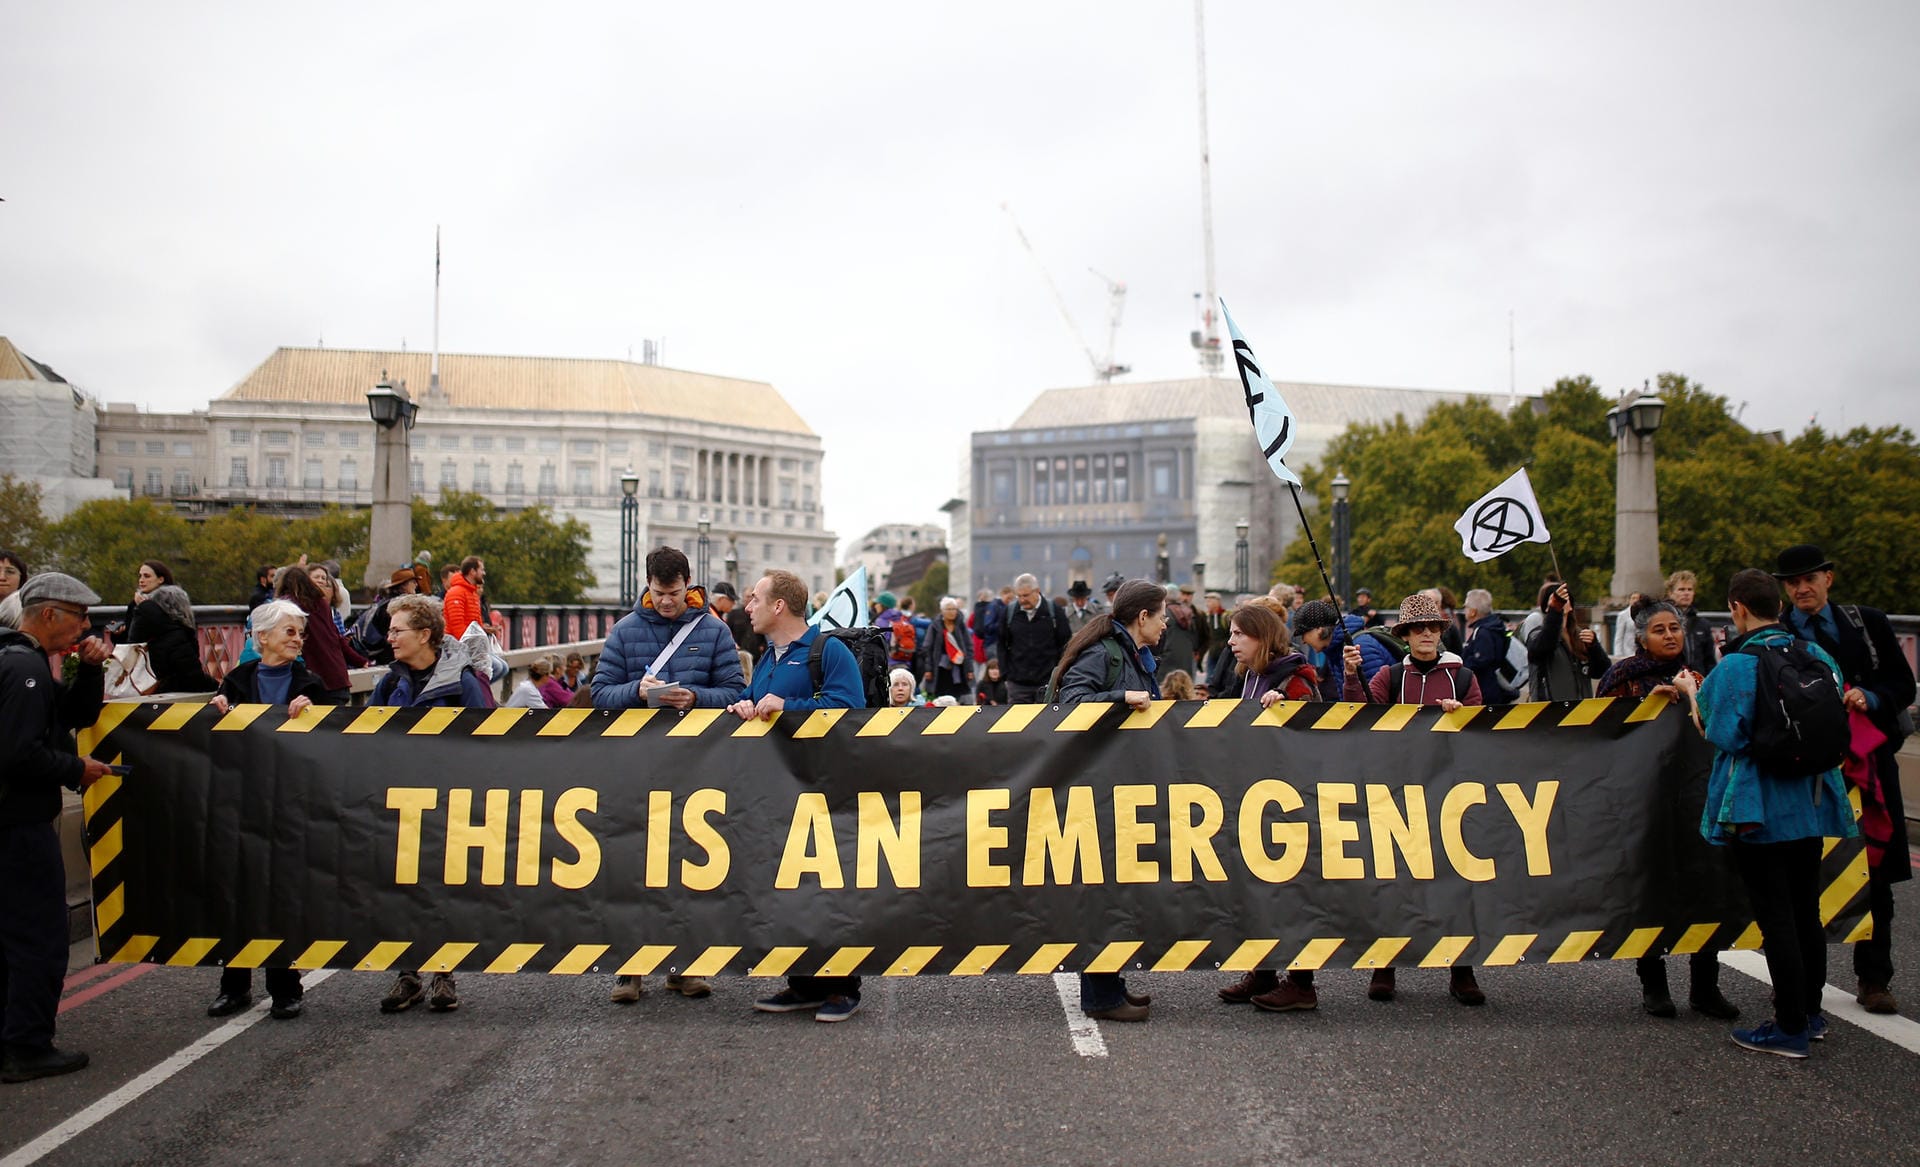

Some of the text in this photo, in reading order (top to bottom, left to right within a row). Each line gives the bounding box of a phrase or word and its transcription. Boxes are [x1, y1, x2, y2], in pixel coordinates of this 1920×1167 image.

[386, 779, 1560, 891] THIS IS AN EMERGENCY
